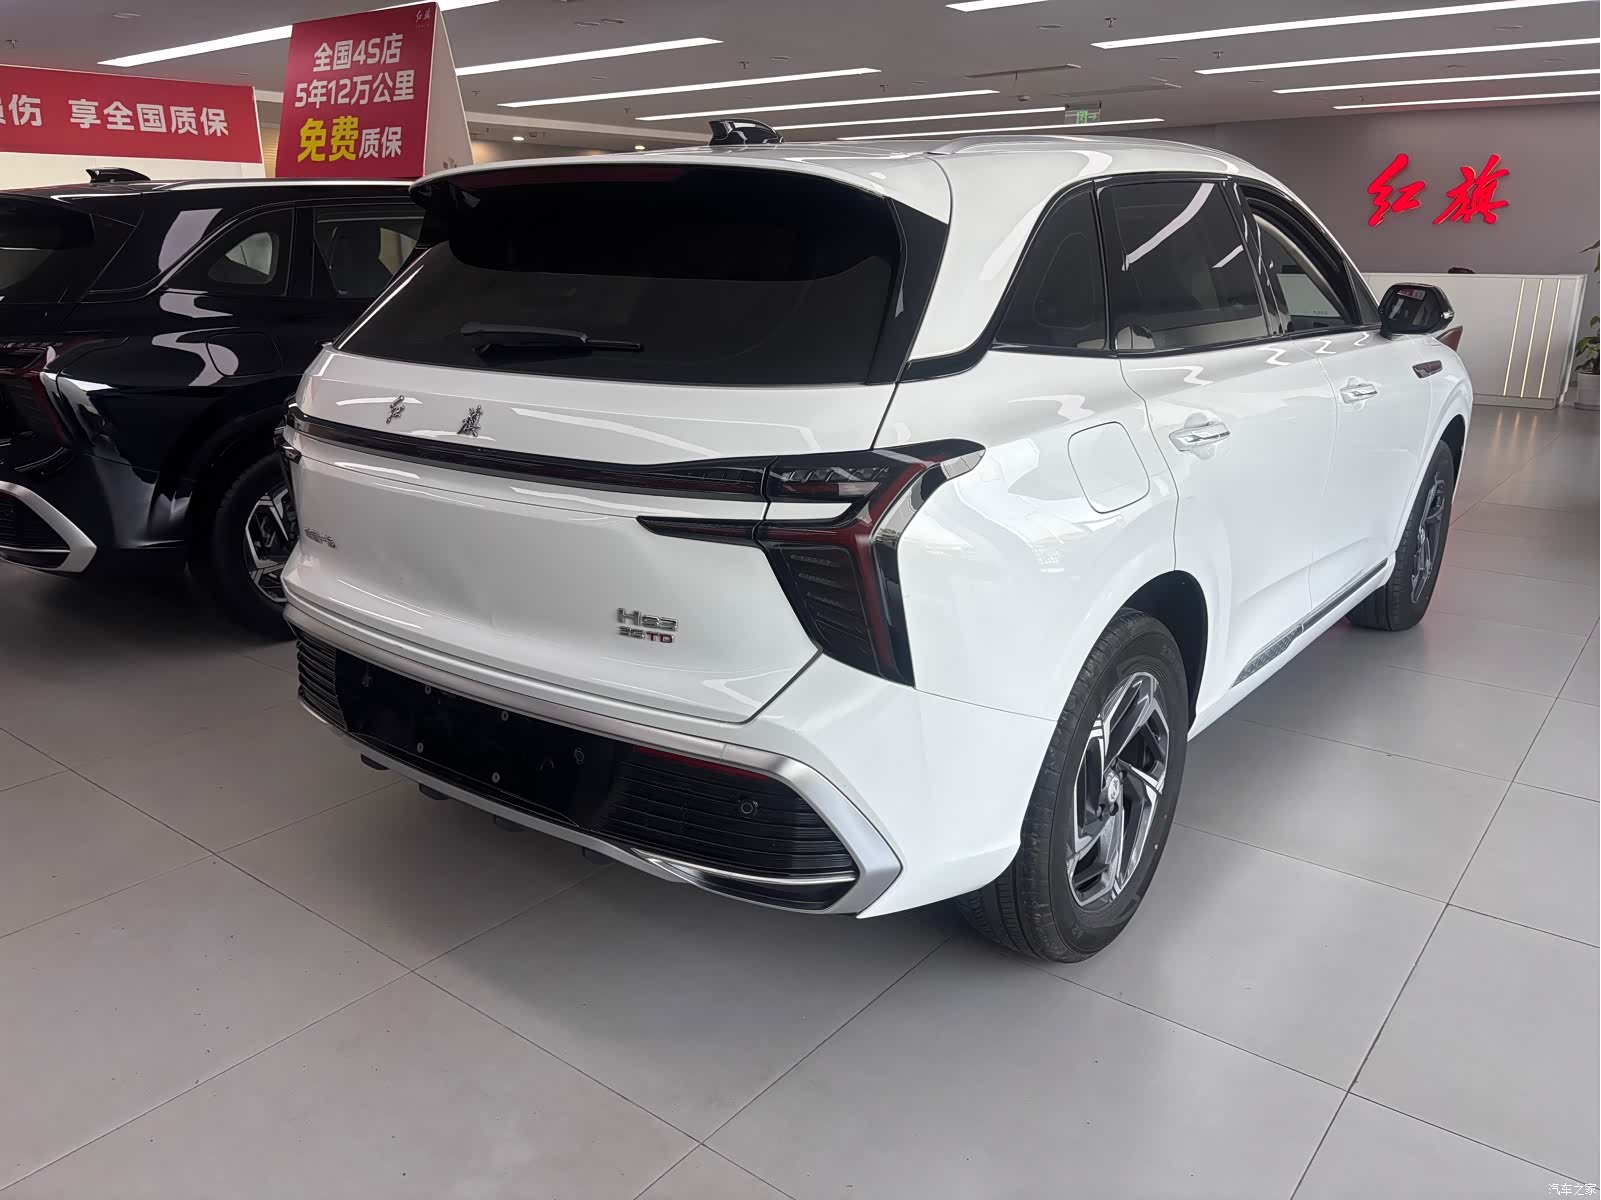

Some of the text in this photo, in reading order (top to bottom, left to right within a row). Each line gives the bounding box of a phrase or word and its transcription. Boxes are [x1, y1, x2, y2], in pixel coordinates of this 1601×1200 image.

[313, 33, 403, 72] 全国4S店
[295, 70, 415, 108] 5年12万公里
[68, 99, 229, 137] 享全国质保
[297, 116, 402, 163] 免费质保
[1367, 153, 1510, 227] 红旗
